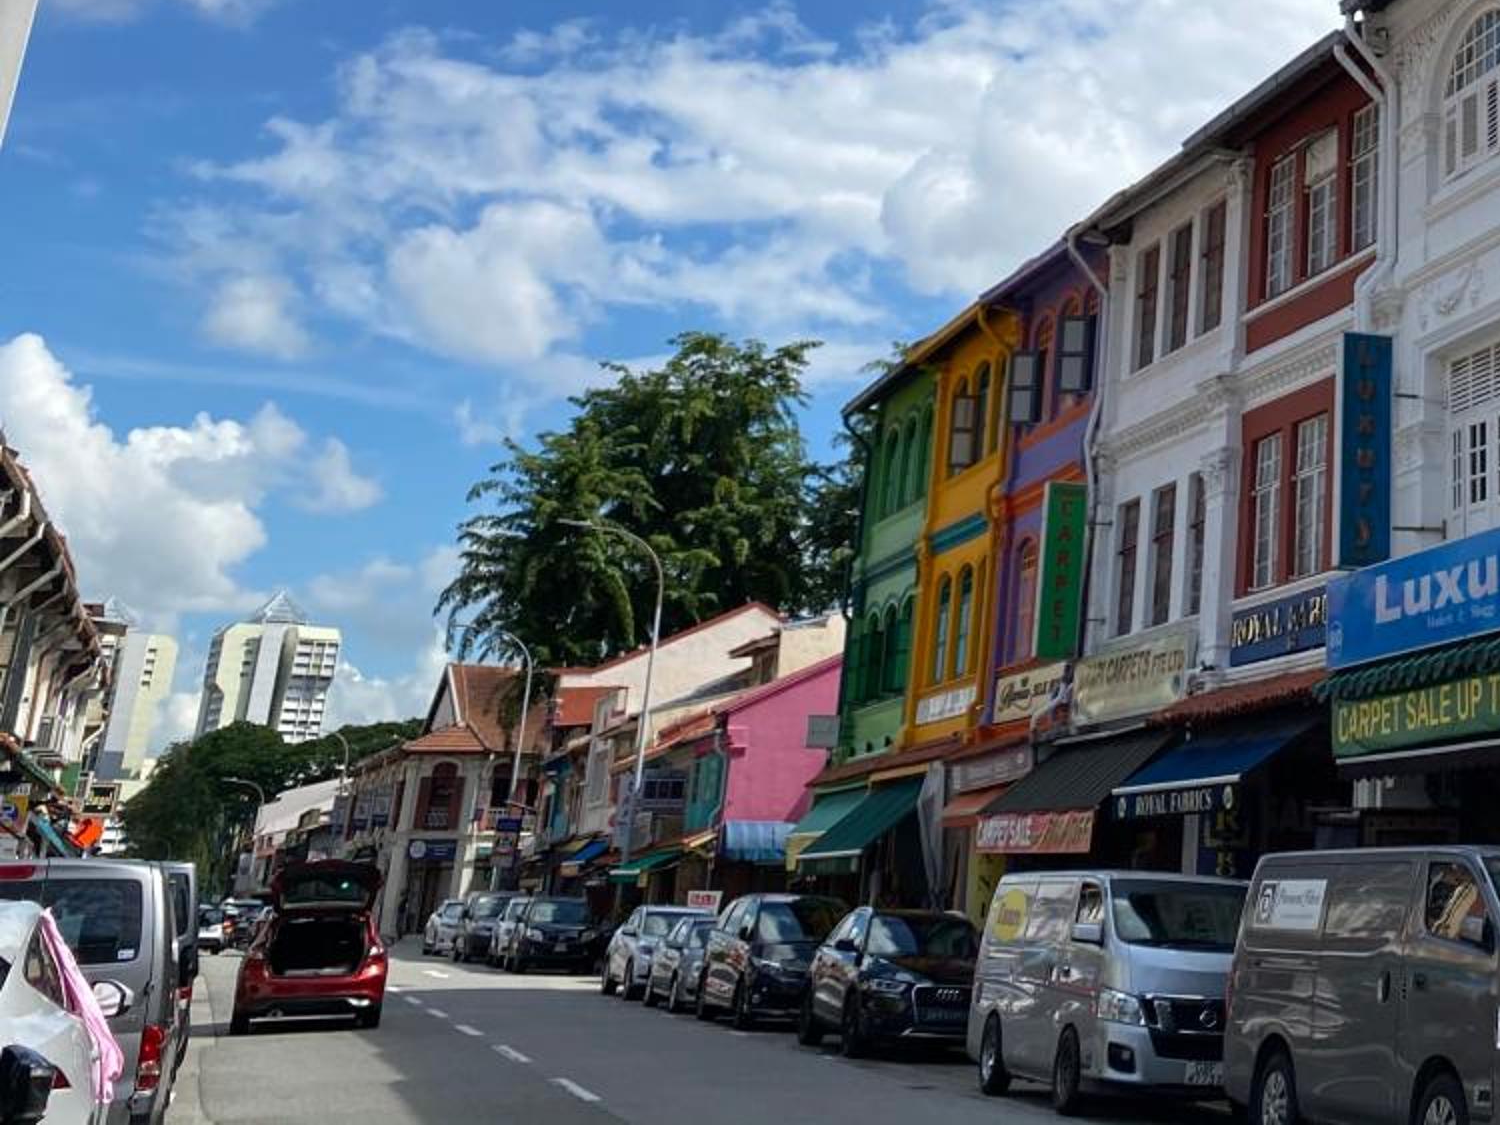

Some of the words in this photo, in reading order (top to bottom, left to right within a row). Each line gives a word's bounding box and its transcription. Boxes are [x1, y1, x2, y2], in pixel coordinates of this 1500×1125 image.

[1232, 607, 1282, 648] ROYAL
[1338, 696, 1400, 743] CARPET
[1405, 686, 1450, 730] SALE
[1457, 677, 1482, 719] UP
[1135, 794, 1166, 816] ROYAL
[1170, 788, 1212, 813] FABRICS
